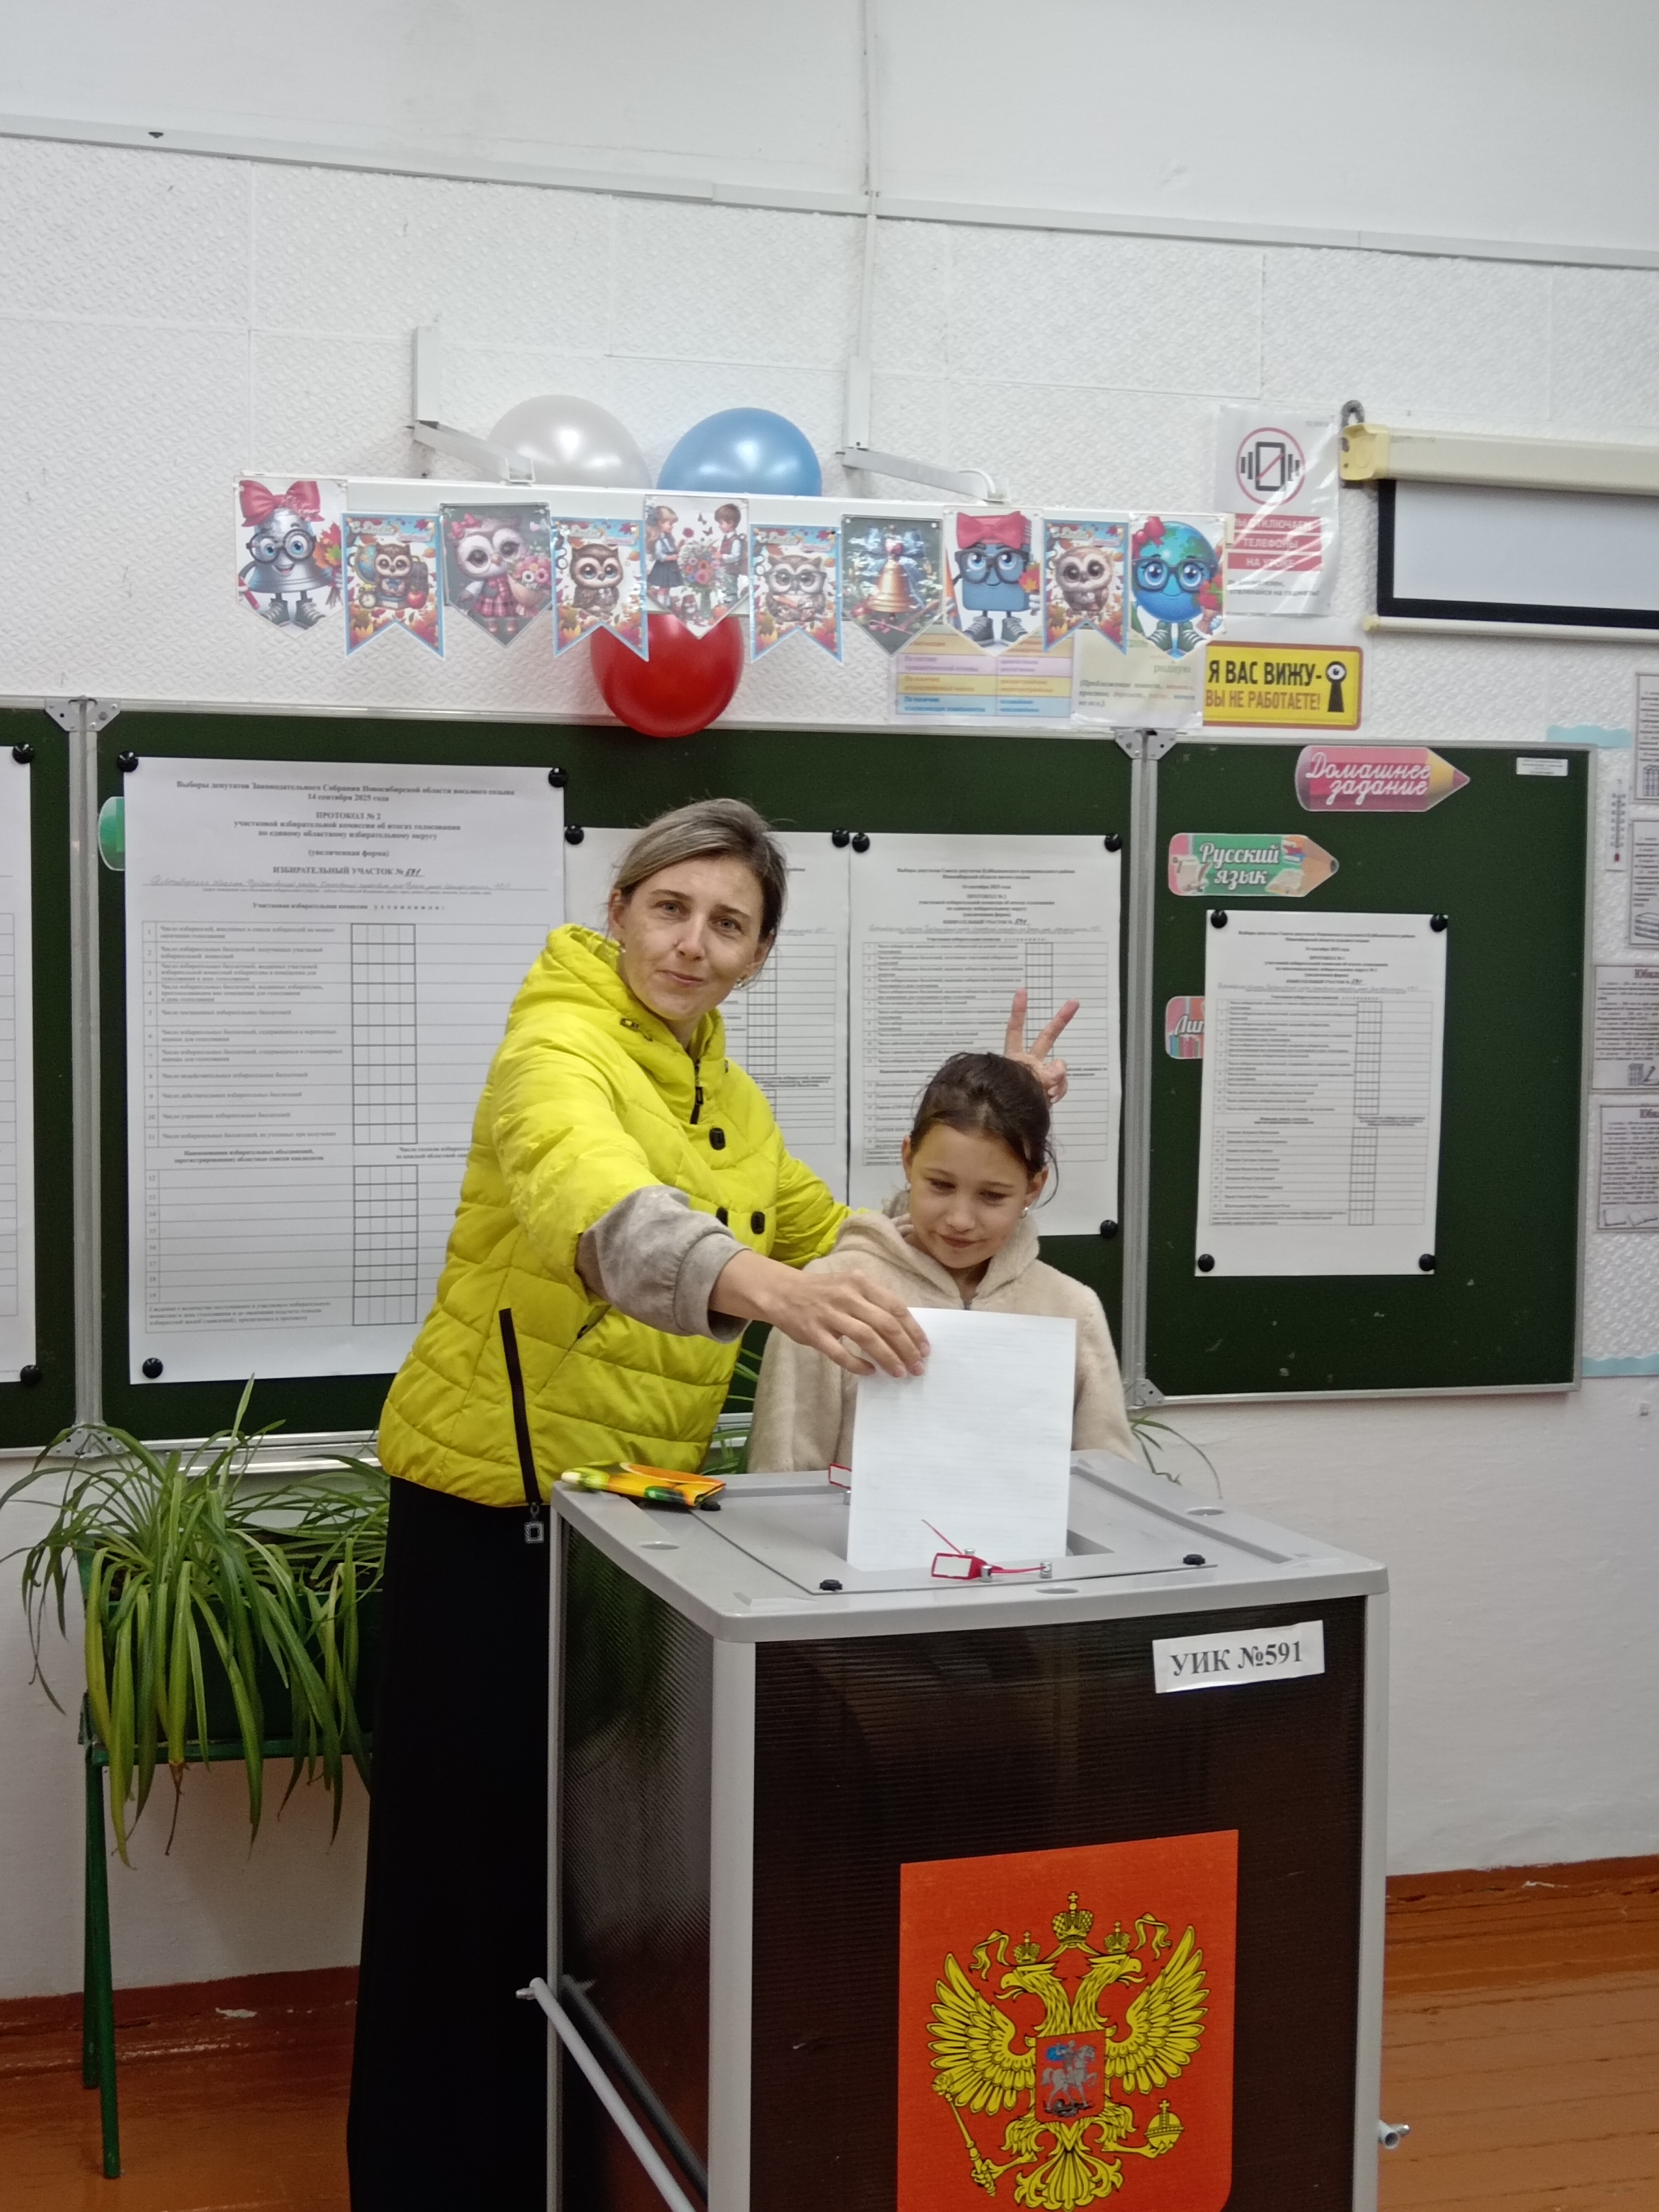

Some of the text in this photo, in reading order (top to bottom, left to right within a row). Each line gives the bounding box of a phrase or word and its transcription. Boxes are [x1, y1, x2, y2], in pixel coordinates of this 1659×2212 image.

[1208, 660, 1322, 687] Я ВАС ВИЖУ-
[1205, 689, 1225, 707] ВЫ
[1229, 690, 1245, 708] НЕ
[1247, 691, 1321, 711] РАБОТАЕТЕ!
[1305, 752, 1431, 779] Домашнее
[1326, 779, 1428, 805] задание
[316, 811, 364, 820] ПРОТОКОЛ
[1200, 842, 1279, 868] Русский
[273, 866, 350, 875] ИЗБИРАТЕЛЬНЫЙ
[352, 867, 393, 876] УЧАСТОК
[1214, 868, 1268, 890] язык
[1169, 1640, 1303, 1676] УИК №591
